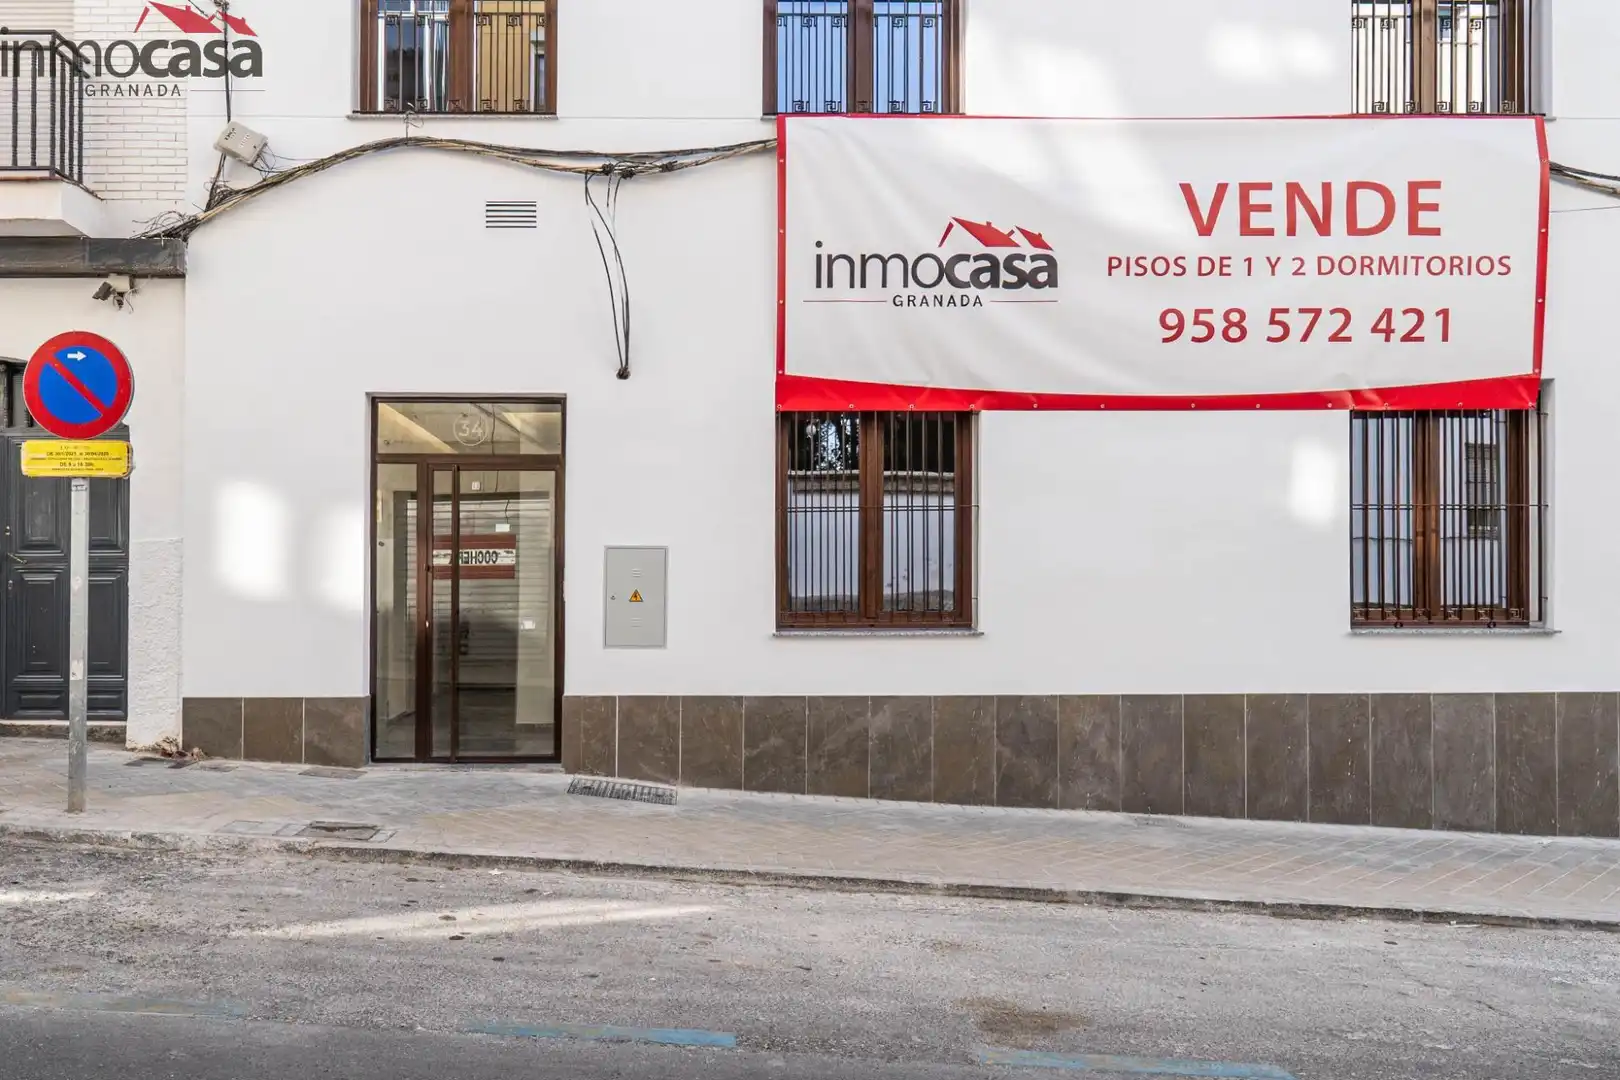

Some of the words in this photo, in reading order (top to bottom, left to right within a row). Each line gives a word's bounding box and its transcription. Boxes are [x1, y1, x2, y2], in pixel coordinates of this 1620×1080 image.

[1180, 179, 1442, 238] VENDE
[815, 240, 1058, 290] inmocasa
[1107, 255, 1186, 277] PISOS
[1197, 255, 1232, 278] DE
[1244, 256, 1253, 276] 1
[1266, 256, 1284, 276] Y
[1292, 255, 1306, 276] 2
[1317, 254, 1512, 278] DORMITORIOS
[892, 294, 984, 307] GRANADA
[1159, 307, 1248, 344] 958
[1266, 306, 1353, 344] 572
[1370, 307, 1452, 343] 421
[458, 419, 483, 437] 34
